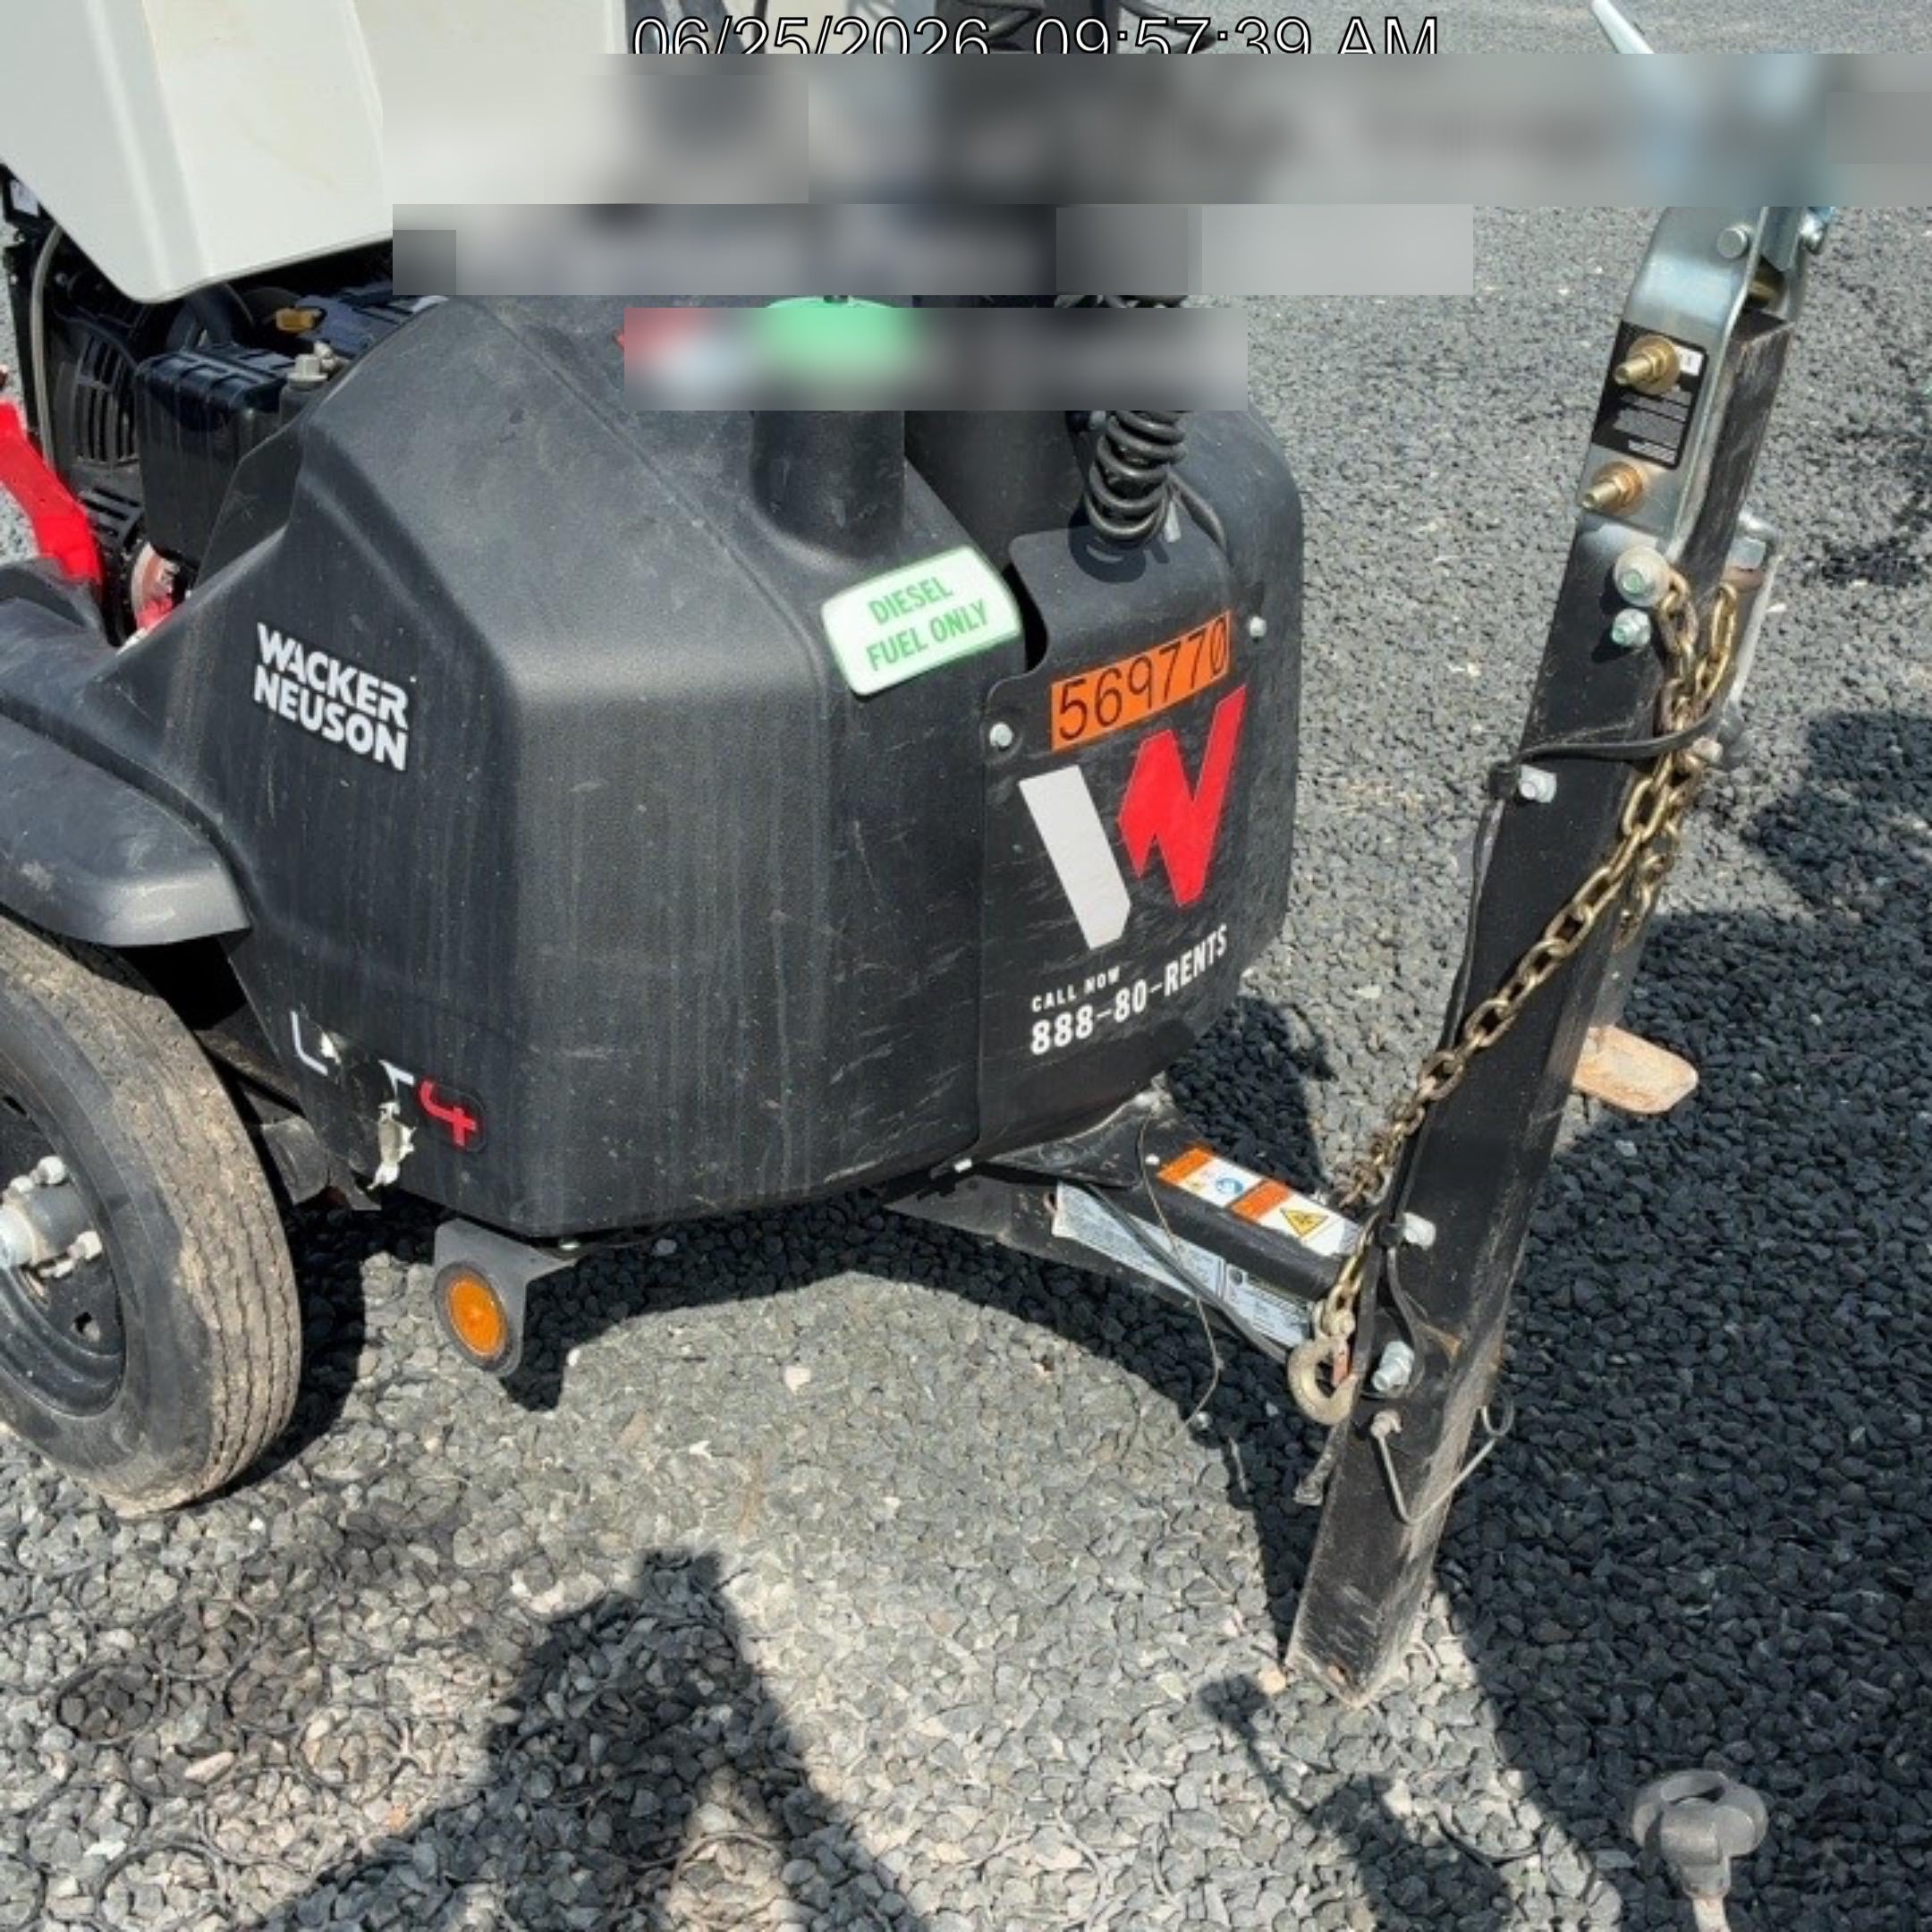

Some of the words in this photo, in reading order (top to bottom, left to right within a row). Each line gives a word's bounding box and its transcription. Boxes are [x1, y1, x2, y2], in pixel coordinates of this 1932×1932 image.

[866, 627, 928, 672] FUEL
[928, 597, 988, 643] ONLY
[869, 576, 953, 624] DIESEL
[253, 664, 408, 772] NEUSON
[257, 622, 409, 731] WACKER
[1059, 617, 1226, 741] 569770
[1030, 923, 1227, 1055] 888-80-RENTS
[1032, 984, 1076, 1013] CALL
[1083, 965, 1120, 995] NOW
